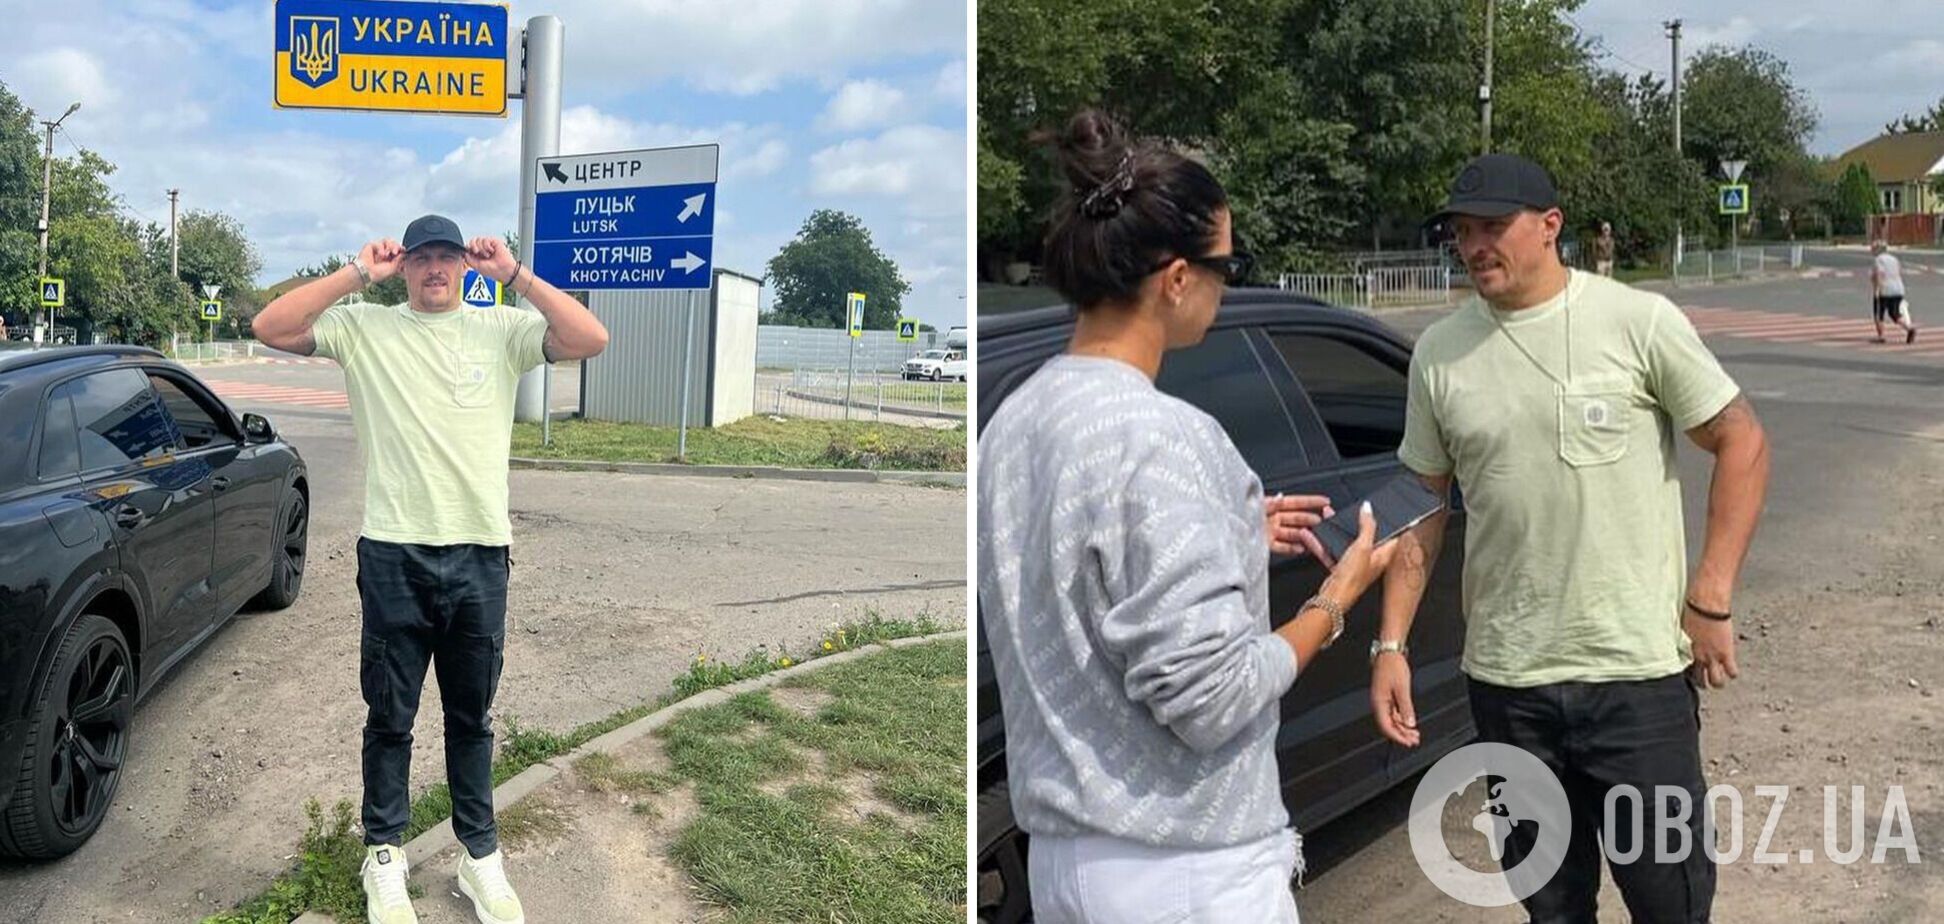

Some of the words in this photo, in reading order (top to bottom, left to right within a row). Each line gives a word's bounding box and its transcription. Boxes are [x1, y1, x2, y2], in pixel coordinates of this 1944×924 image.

[352, 13, 494, 46] УКРАЇНА
[350, 68, 485, 97] UKRAINE
[575, 160, 642, 184] ЦЕНТР
[573, 195, 636, 217] ЛУЦЬК
[572, 219, 618, 234] LUTSK
[572, 246, 652, 264] ХОТЯЧІВ
[570, 269, 666, 283] KHOTYACHIV
